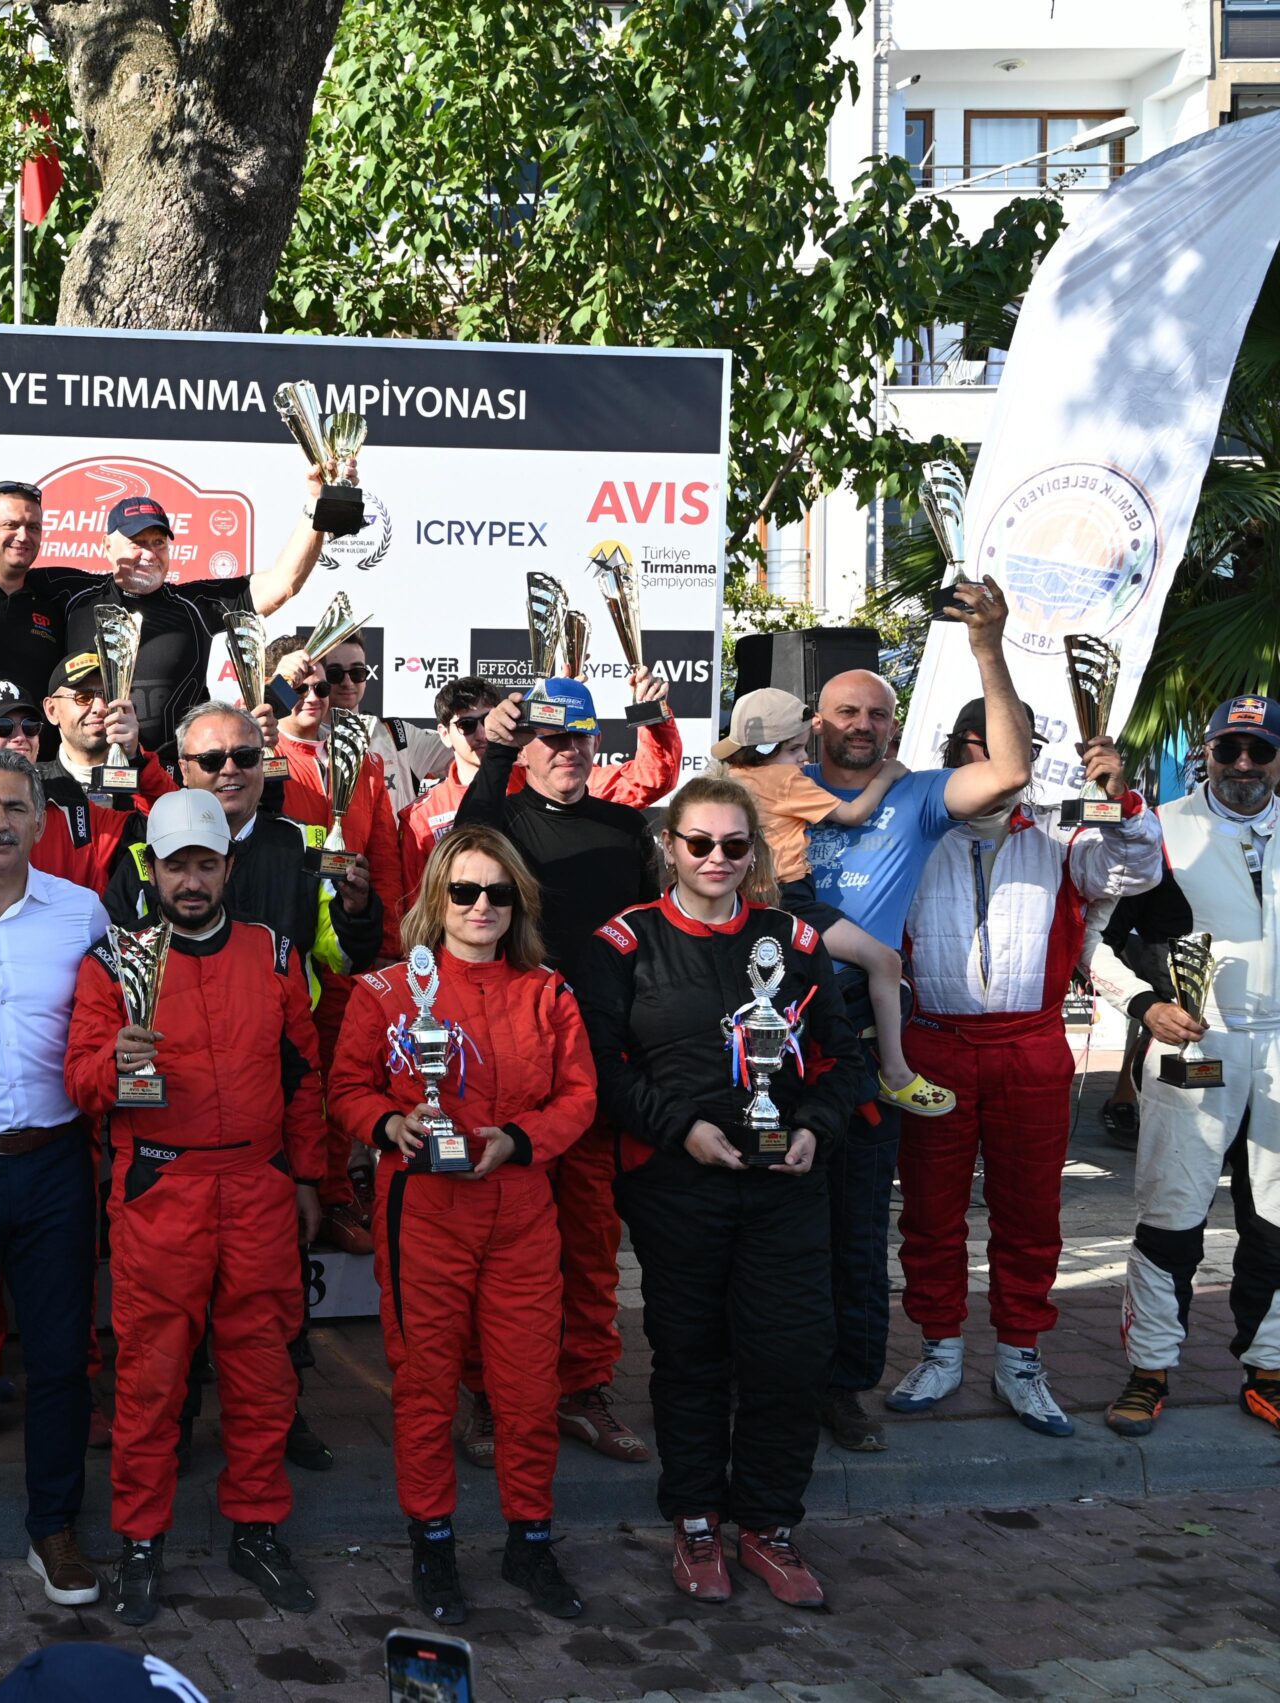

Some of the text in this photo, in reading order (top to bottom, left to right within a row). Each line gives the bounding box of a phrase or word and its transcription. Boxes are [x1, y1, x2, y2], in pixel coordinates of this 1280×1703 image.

[56, 374, 267, 412] TIRMANMA
[277, 379, 526, 420] MPİYONASI
[586, 480, 710, 525] AVIS
[416, 519, 548, 547] ICRYPEX
[641, 545, 691, 562] Türkiye
[641, 560, 717, 574] Tırmanma
[641, 575, 717, 590] Şampiyonası
[394, 657, 459, 672] POWER
[651, 660, 709, 682] AVIS
[76, 806, 87, 838] sparco
[601, 925, 629, 947] sparco
[140, 1146, 177, 1160] sparco
